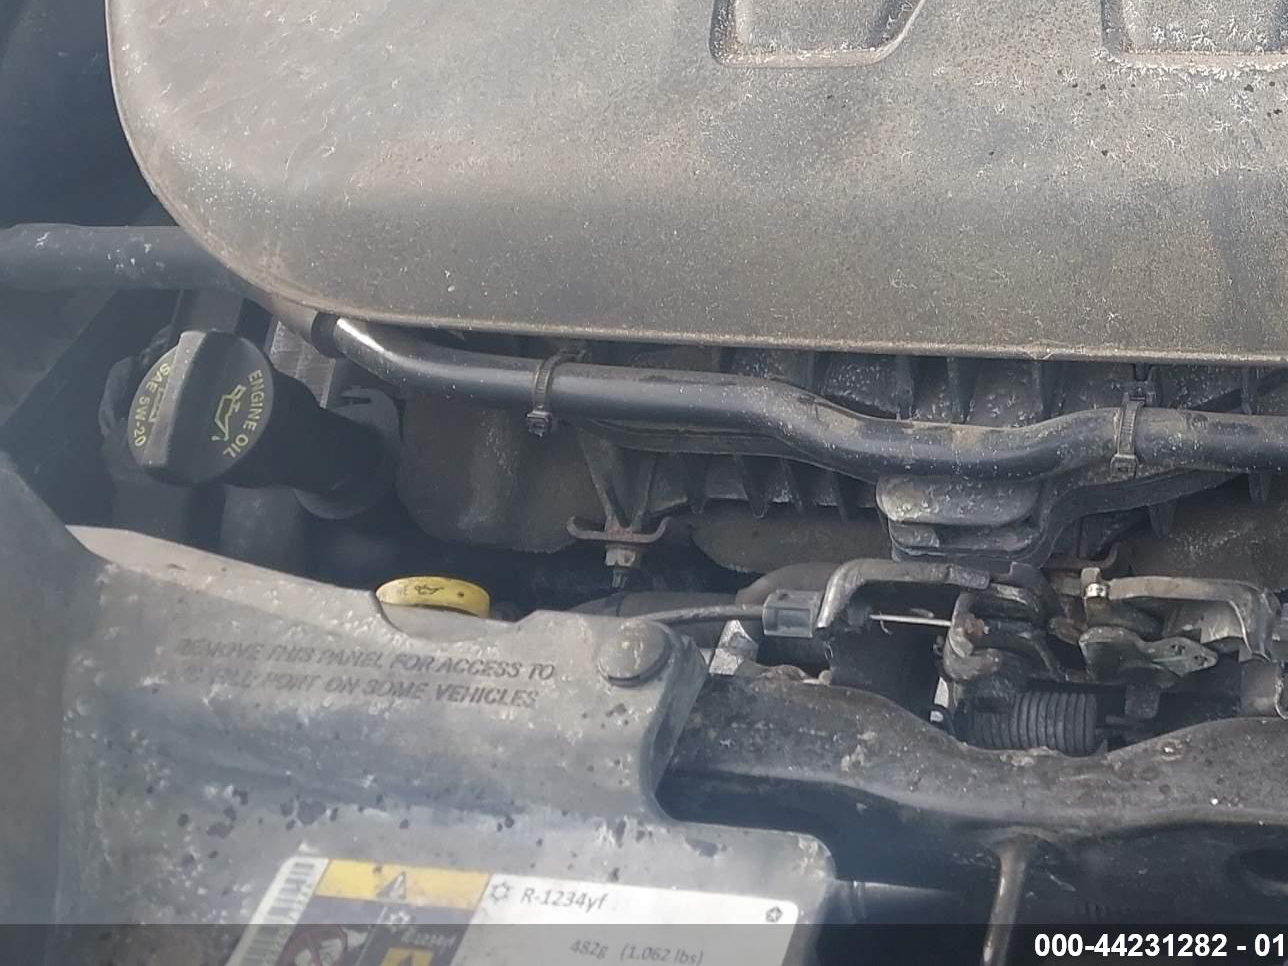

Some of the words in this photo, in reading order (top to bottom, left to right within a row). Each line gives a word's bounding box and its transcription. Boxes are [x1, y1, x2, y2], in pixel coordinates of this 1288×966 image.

[145, 362, 173, 393] SAE
[242, 369, 266, 431] ENGINE
[133, 395, 151, 447] 5W-20
[222, 433, 250, 459] OIL
[266, 643, 317, 663] THIS
[318, 648, 385, 669] PANEL
[389, 651, 436, 674] FOR
[434, 656, 524, 679] ACCESS
[528, 662, 556, 681] TO
[324, 676, 361, 696] ON
[362, 679, 429, 701] SOME
[434, 684, 540, 708] VEHICLES
[519, 887, 609, 914] R-1234yf
[568, 939, 610, 961] 482g
[618, 942, 671, 963] (1.062
[673, 948, 705, 966] lbs)
